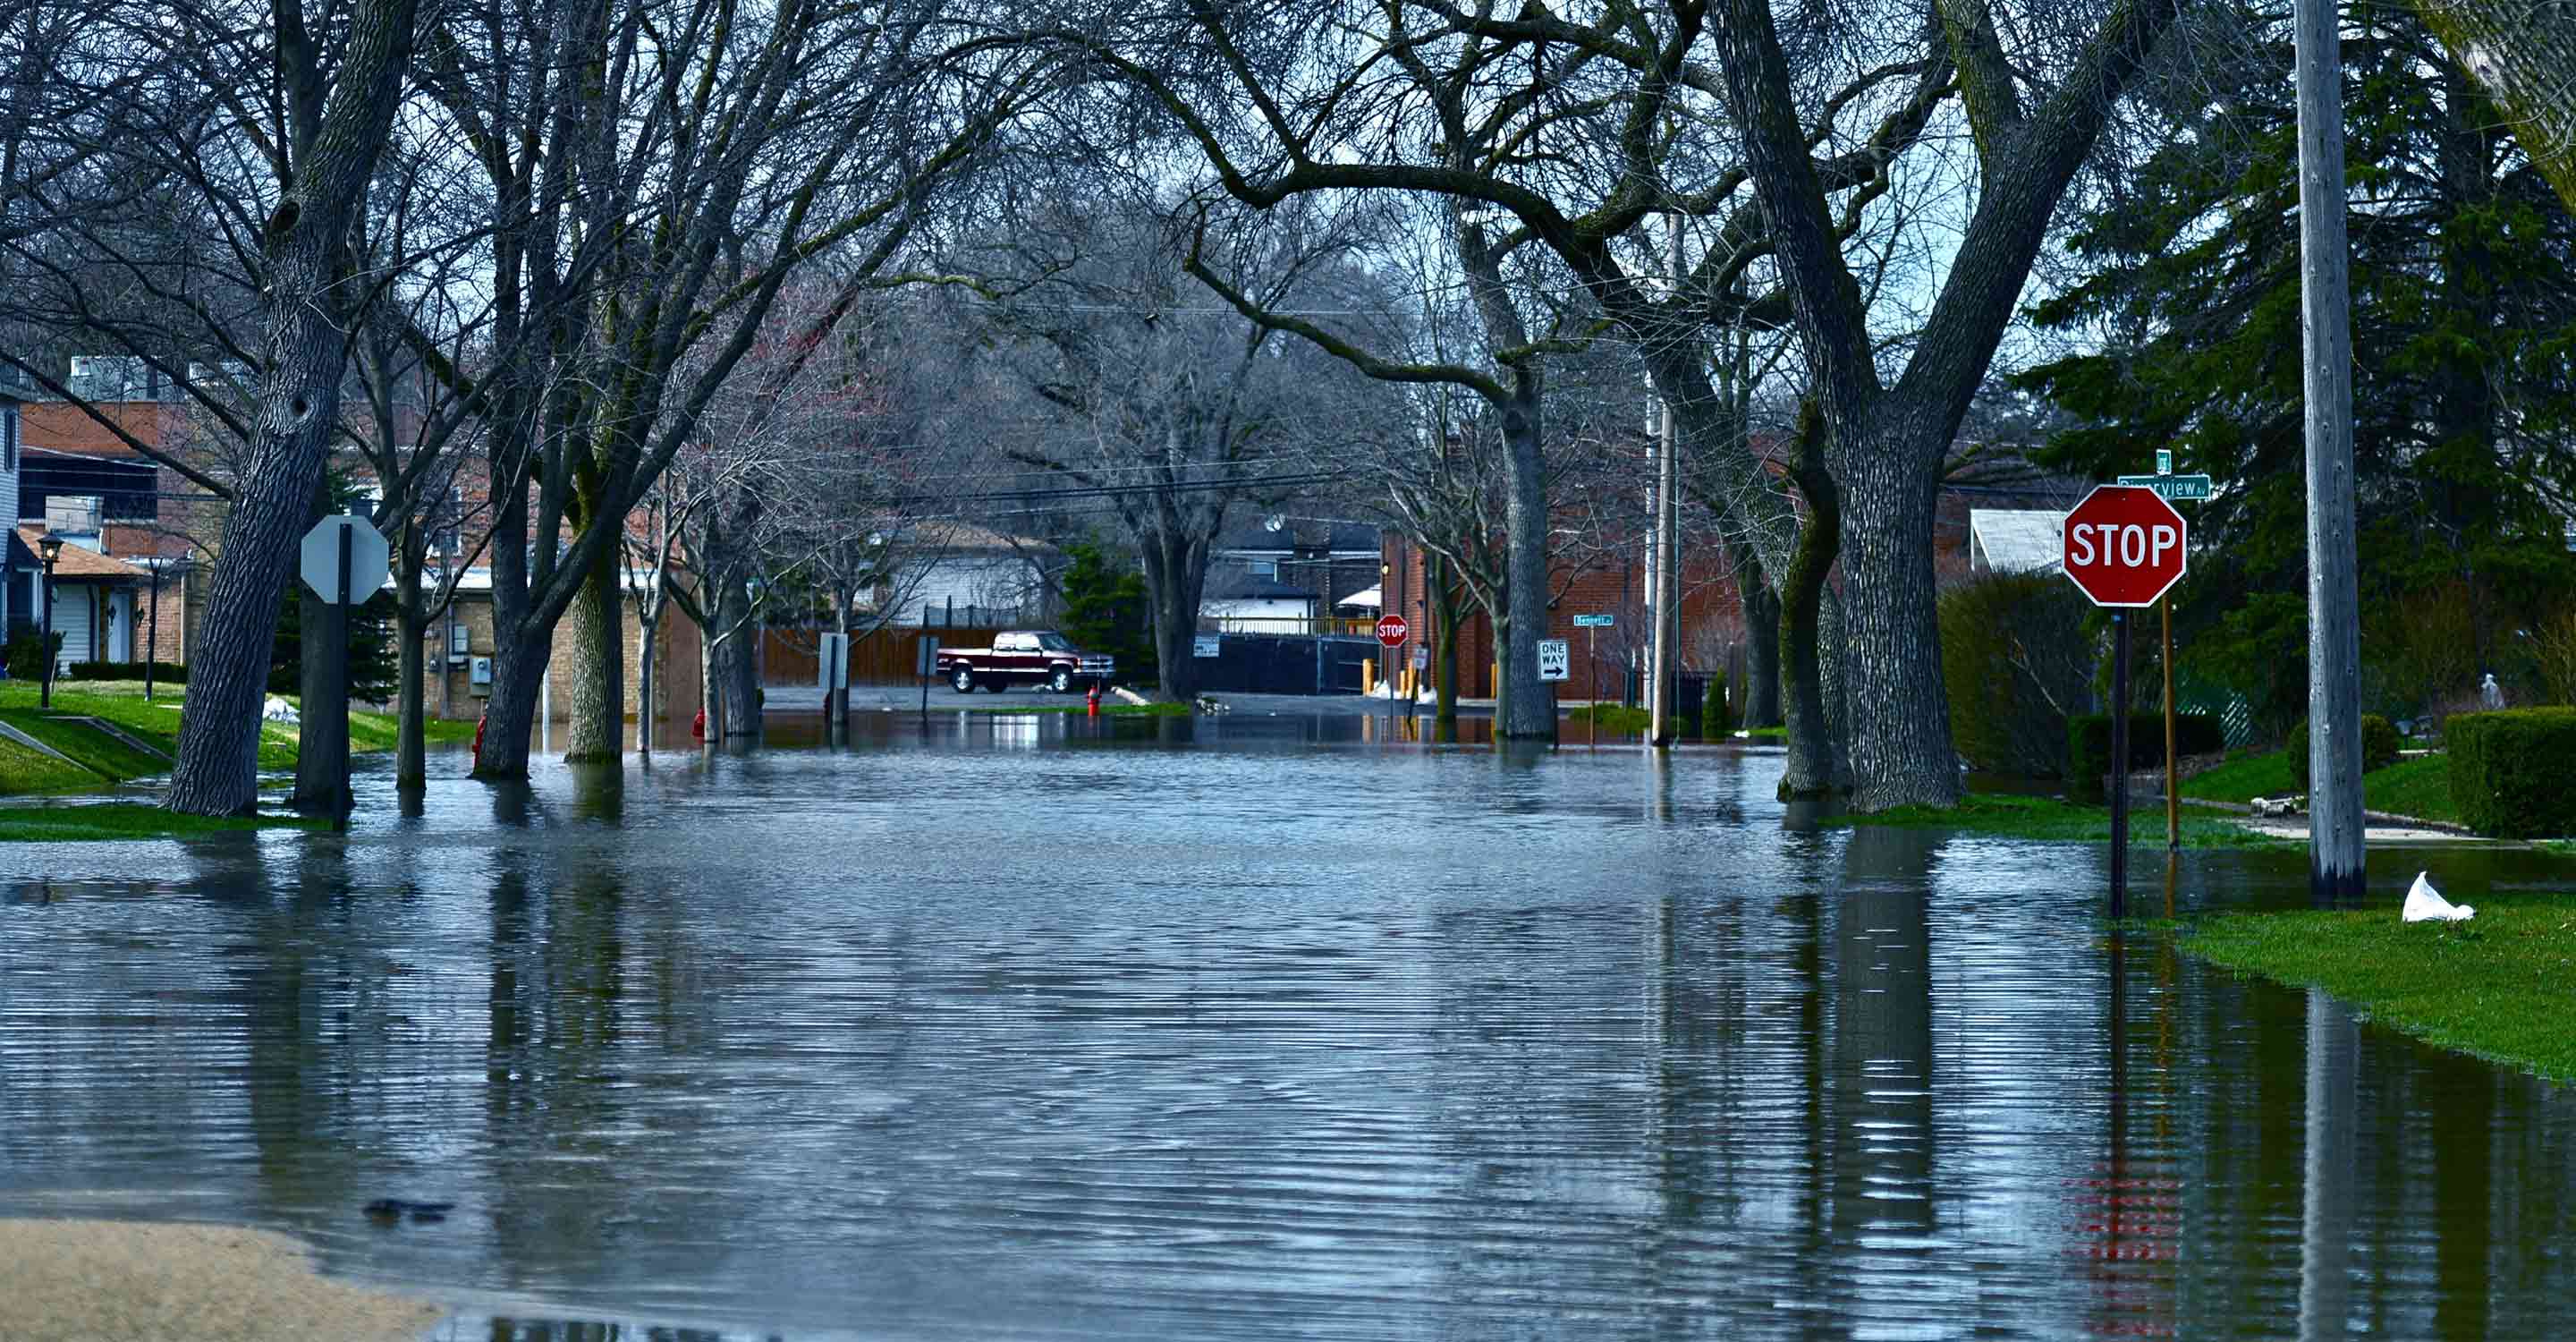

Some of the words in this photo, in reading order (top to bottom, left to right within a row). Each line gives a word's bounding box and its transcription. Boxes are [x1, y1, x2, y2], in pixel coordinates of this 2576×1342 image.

[2071, 523, 2176, 567] STOP
[1379, 624, 1405, 637] STOP
[1543, 644, 1564, 653] ONE
[1542, 655, 1564, 665] WAY
